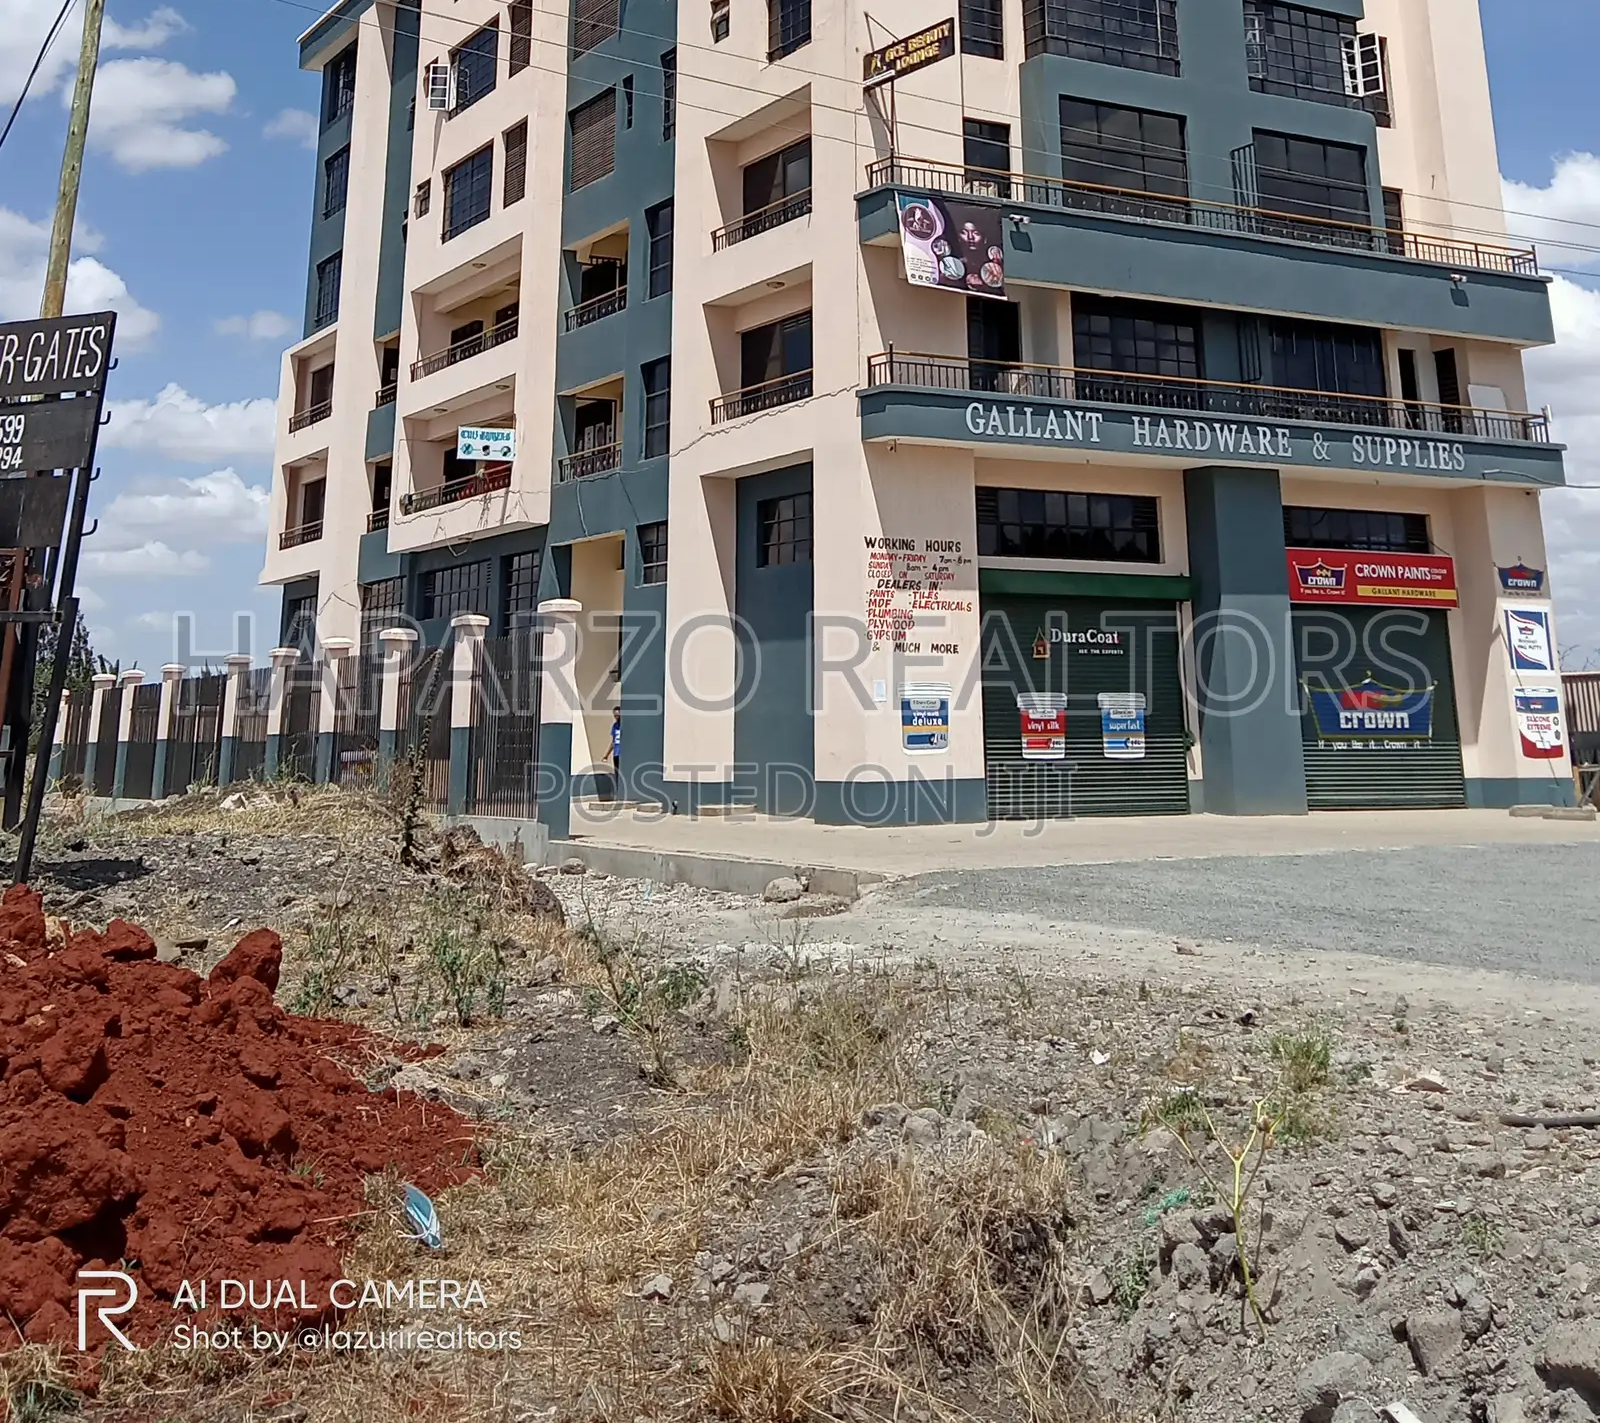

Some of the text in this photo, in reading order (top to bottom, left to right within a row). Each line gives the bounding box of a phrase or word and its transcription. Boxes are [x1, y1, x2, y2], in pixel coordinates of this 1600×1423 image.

[885, 23, 950, 62] ACE BEAUTY
[896, 42, 940, 71] LOUNGE
[0, 325, 105, 384] R-GATES
[965, 401, 1466, 471] GALLANT HARDWARE & SUPPLIES
[864, 536, 961, 553] WORKING HOURS
[868, 561, 893, 570] SUNDAY
[906, 563, 921, 572] 8am
[932, 564, 949, 573] 4pm
[1355, 563, 1431, 580] CROWN PAINTS
[867, 569, 955, 581] CLOSED ON SATURDAY
[1308, 576, 1336, 586] crown
[877, 579, 921, 591] DEALERS
[1507, 578, 1537, 588] crown
[868, 589, 895, 598] PAINTS
[912, 591, 939, 600] TILES
[1371, 587, 1436, 597] GALLANT HARDWARE
[868, 598, 892, 608] MDF
[912, 600, 972, 612] ELECTRICALS
[867, 608, 913, 620] PLUMBING
[867, 619, 915, 630] PLYWOOD
[866, 630, 906, 641] GYPSUM
[1050, 628, 1119, 644] DuraCoat
[872, 642, 959, 654] & MUCH MORE
[912, 717, 942, 726] deluxe
[1339, 711, 1410, 729] crown
[1027, 721, 1045, 732] vinyl
[1333, 741, 1347, 751] you
